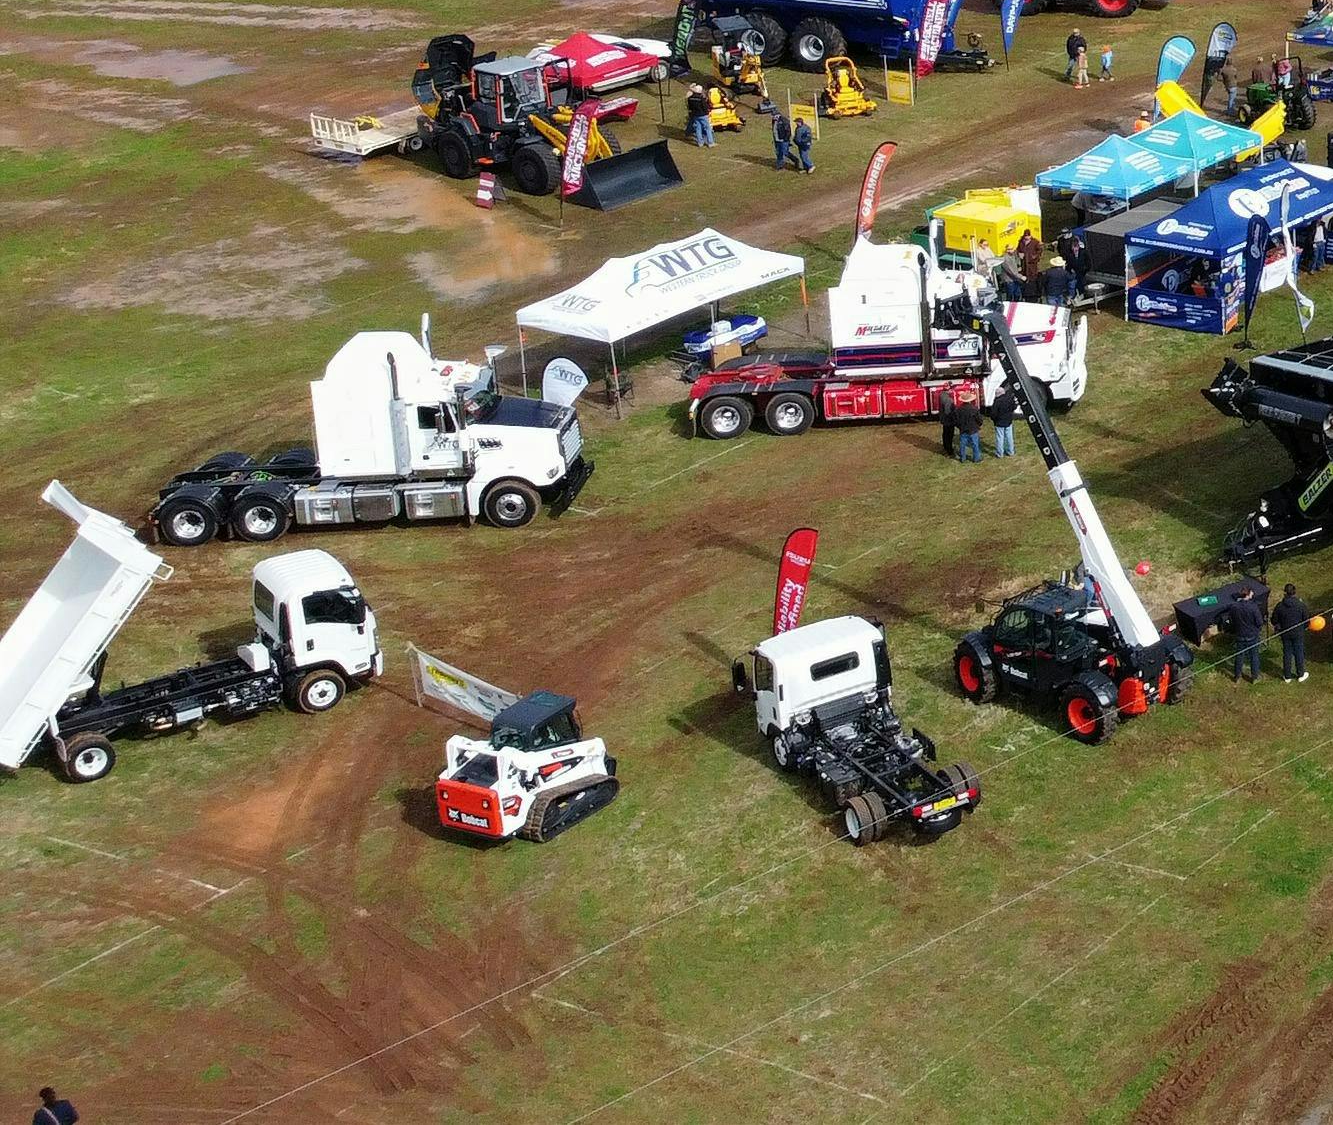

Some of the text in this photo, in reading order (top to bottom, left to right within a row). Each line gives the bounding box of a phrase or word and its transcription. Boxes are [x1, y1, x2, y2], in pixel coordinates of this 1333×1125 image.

[861, 152, 887, 218] GAAMBEN
[649, 237, 736, 277] WTG
[760, 266, 790, 279] MACK
[561, 294, 600, 312] WTG
[558, 368, 583, 386] WTG
